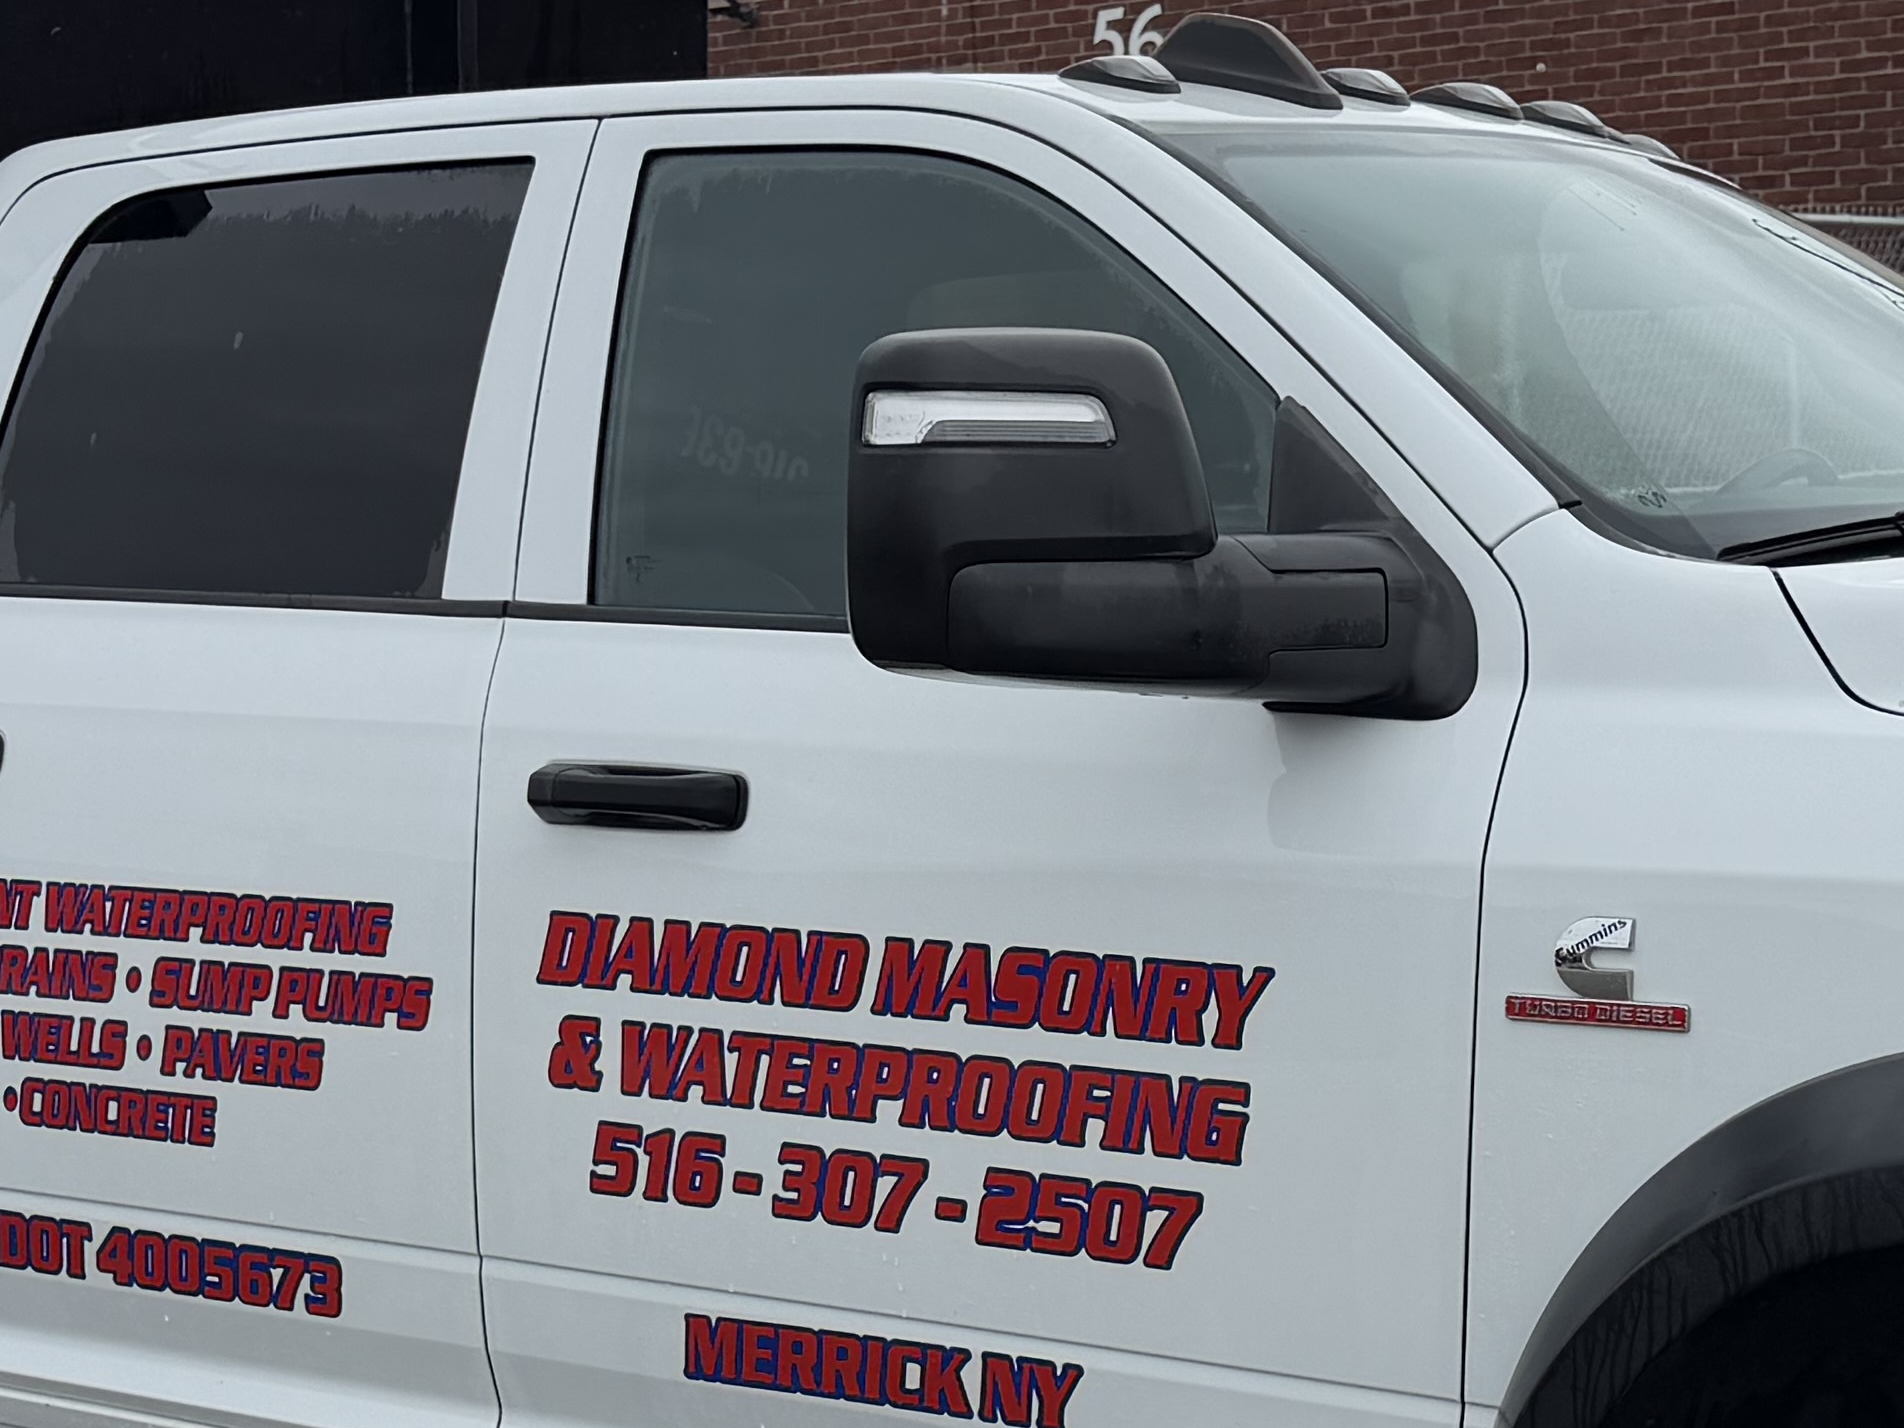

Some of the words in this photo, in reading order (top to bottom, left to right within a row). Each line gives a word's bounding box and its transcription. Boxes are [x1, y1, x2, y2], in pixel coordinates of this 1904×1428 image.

[1093, 3, 1164, 56] 56
[43, 882, 393, 957] WATERPROOFING
[1554, 918, 1628, 967] Cummins
[149, 958, 271, 1016] SUMP
[272, 967, 434, 1030] PUMPS
[536, 911, 869, 1012] DIAMOND
[871, 936, 1275, 1050] MASONRY
[1509, 999, 1589, 1018] TURBO
[1595, 1005, 1684, 1025] DIESEL
[0, 1011, 127, 1069] WELLS
[160, 1025, 325, 1091] PAVERS
[19, 1078, 217, 1147] CONCRETE
[547, 1014, 603, 1091] &
[620, 1019, 1251, 1165] WATERPROOFING
[95, 1227, 343, 1318] 4005673
[683, 1313, 974, 1420] MERRICK
